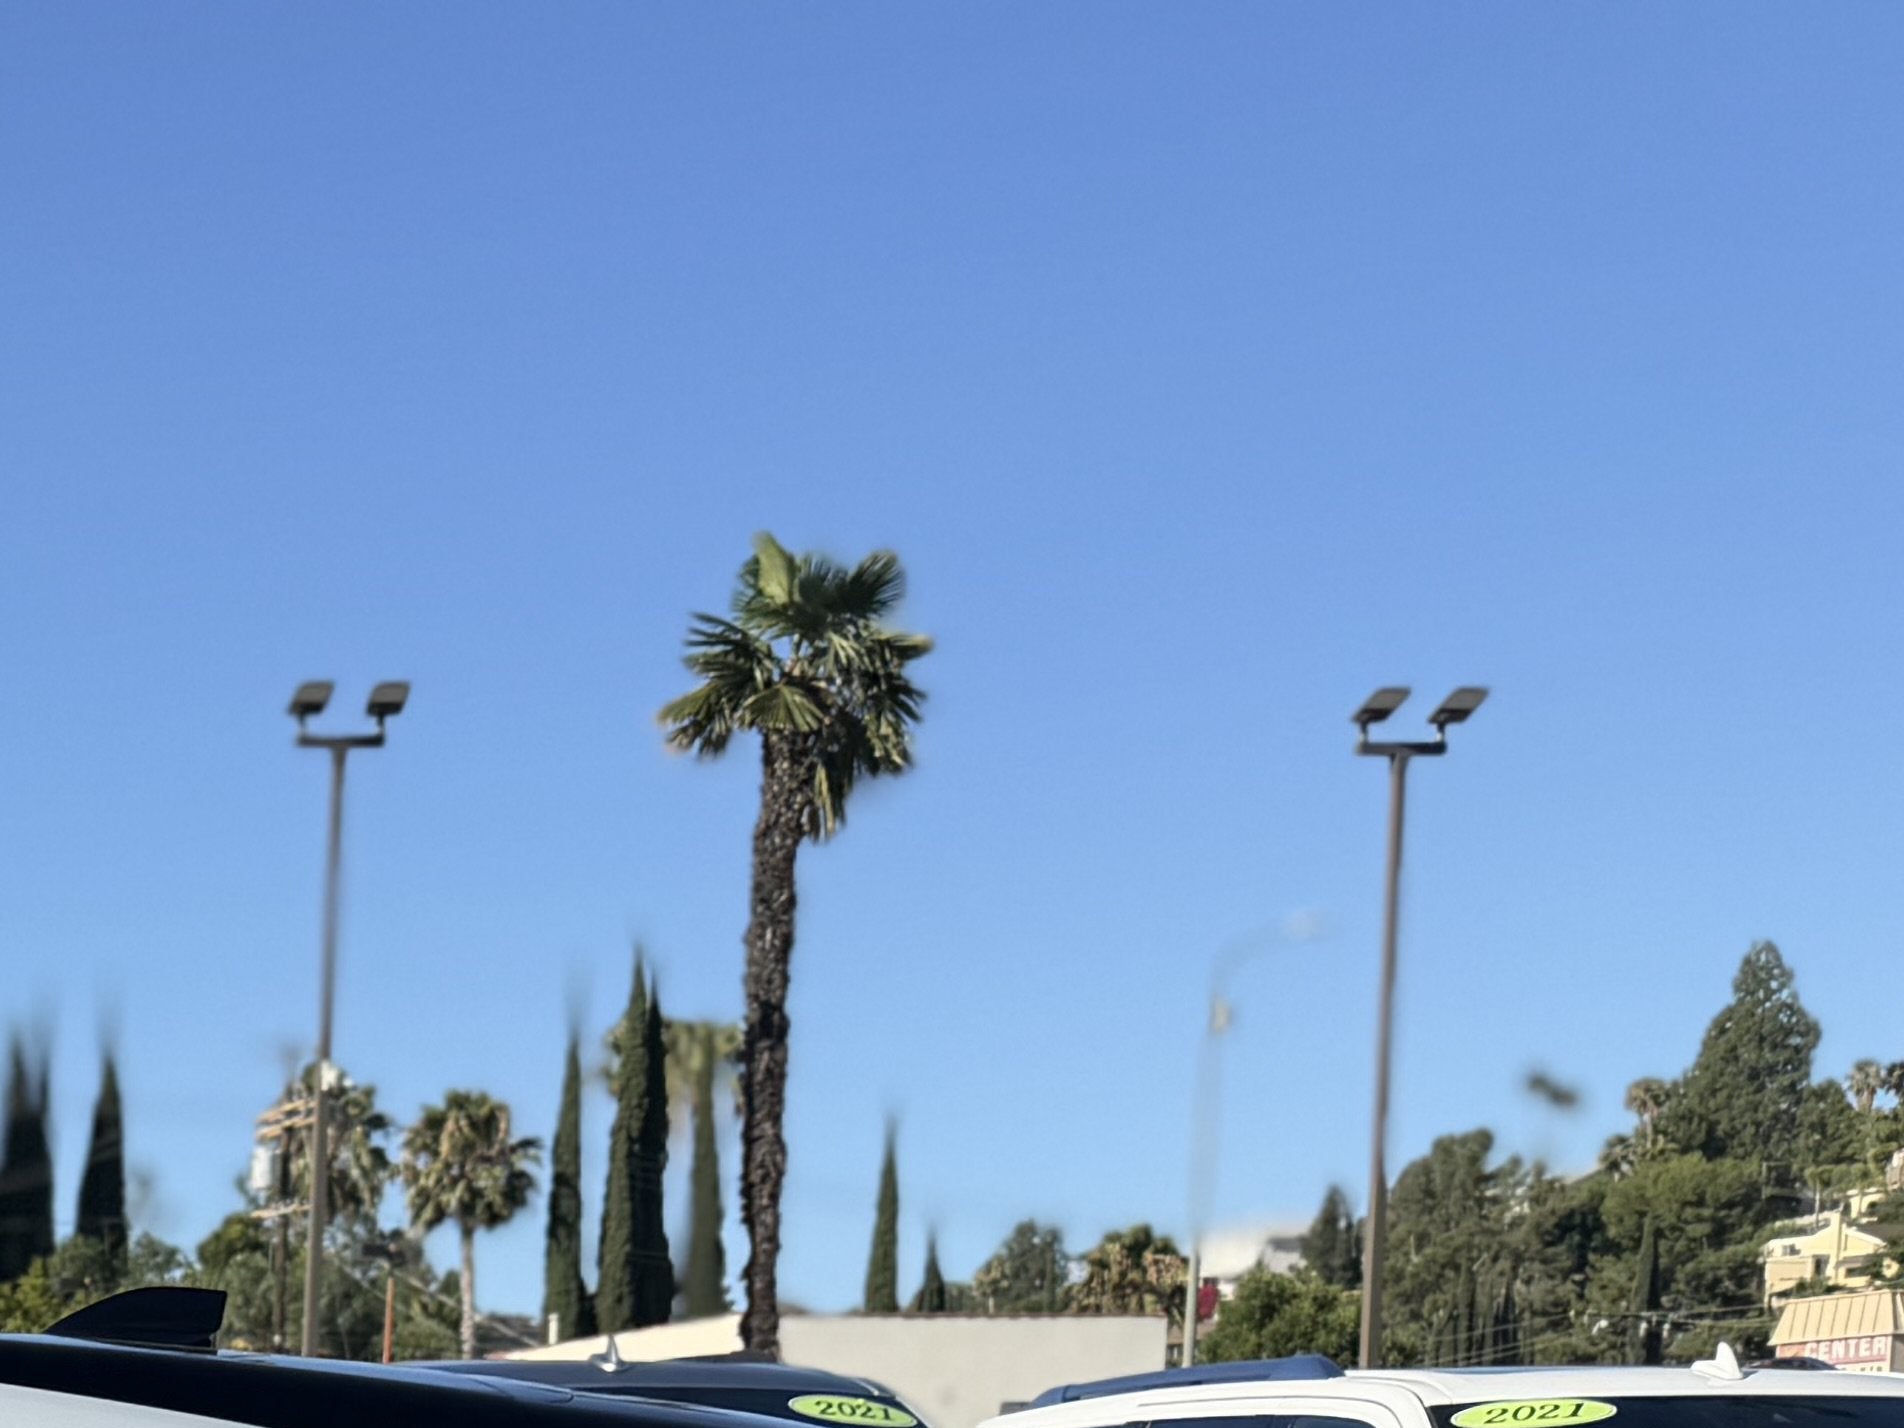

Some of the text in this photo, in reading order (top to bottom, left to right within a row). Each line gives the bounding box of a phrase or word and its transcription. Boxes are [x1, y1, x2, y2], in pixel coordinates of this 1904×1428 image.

[1804, 1335, 1888, 1360] CENTER
[814, 1399, 895, 1422] 2021
[1484, 1402, 1585, 1425] 2021
